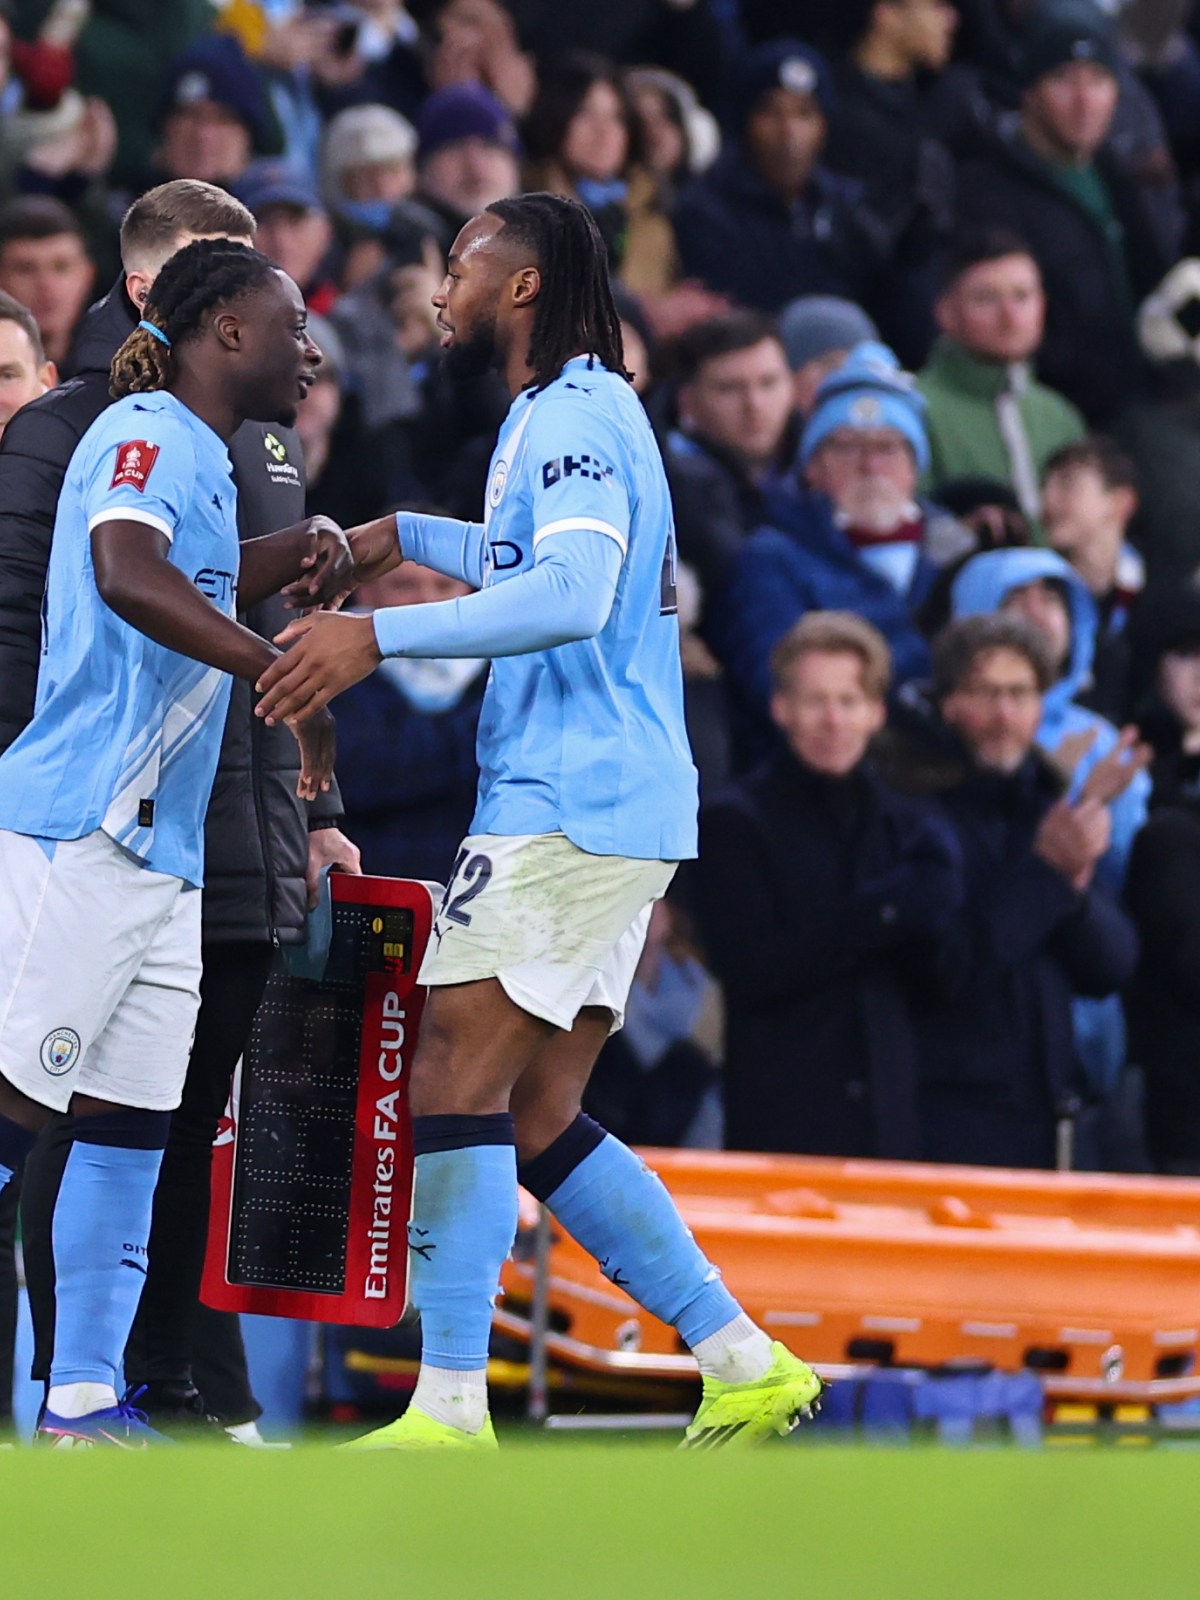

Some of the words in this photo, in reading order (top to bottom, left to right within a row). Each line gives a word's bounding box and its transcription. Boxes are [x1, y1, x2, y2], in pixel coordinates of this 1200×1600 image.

[124, 468, 144, 480] CUP
[378, 991, 406, 1082] CUP
[373, 1089, 400, 1141] FA
[364, 1146, 395, 1299] Emirates
